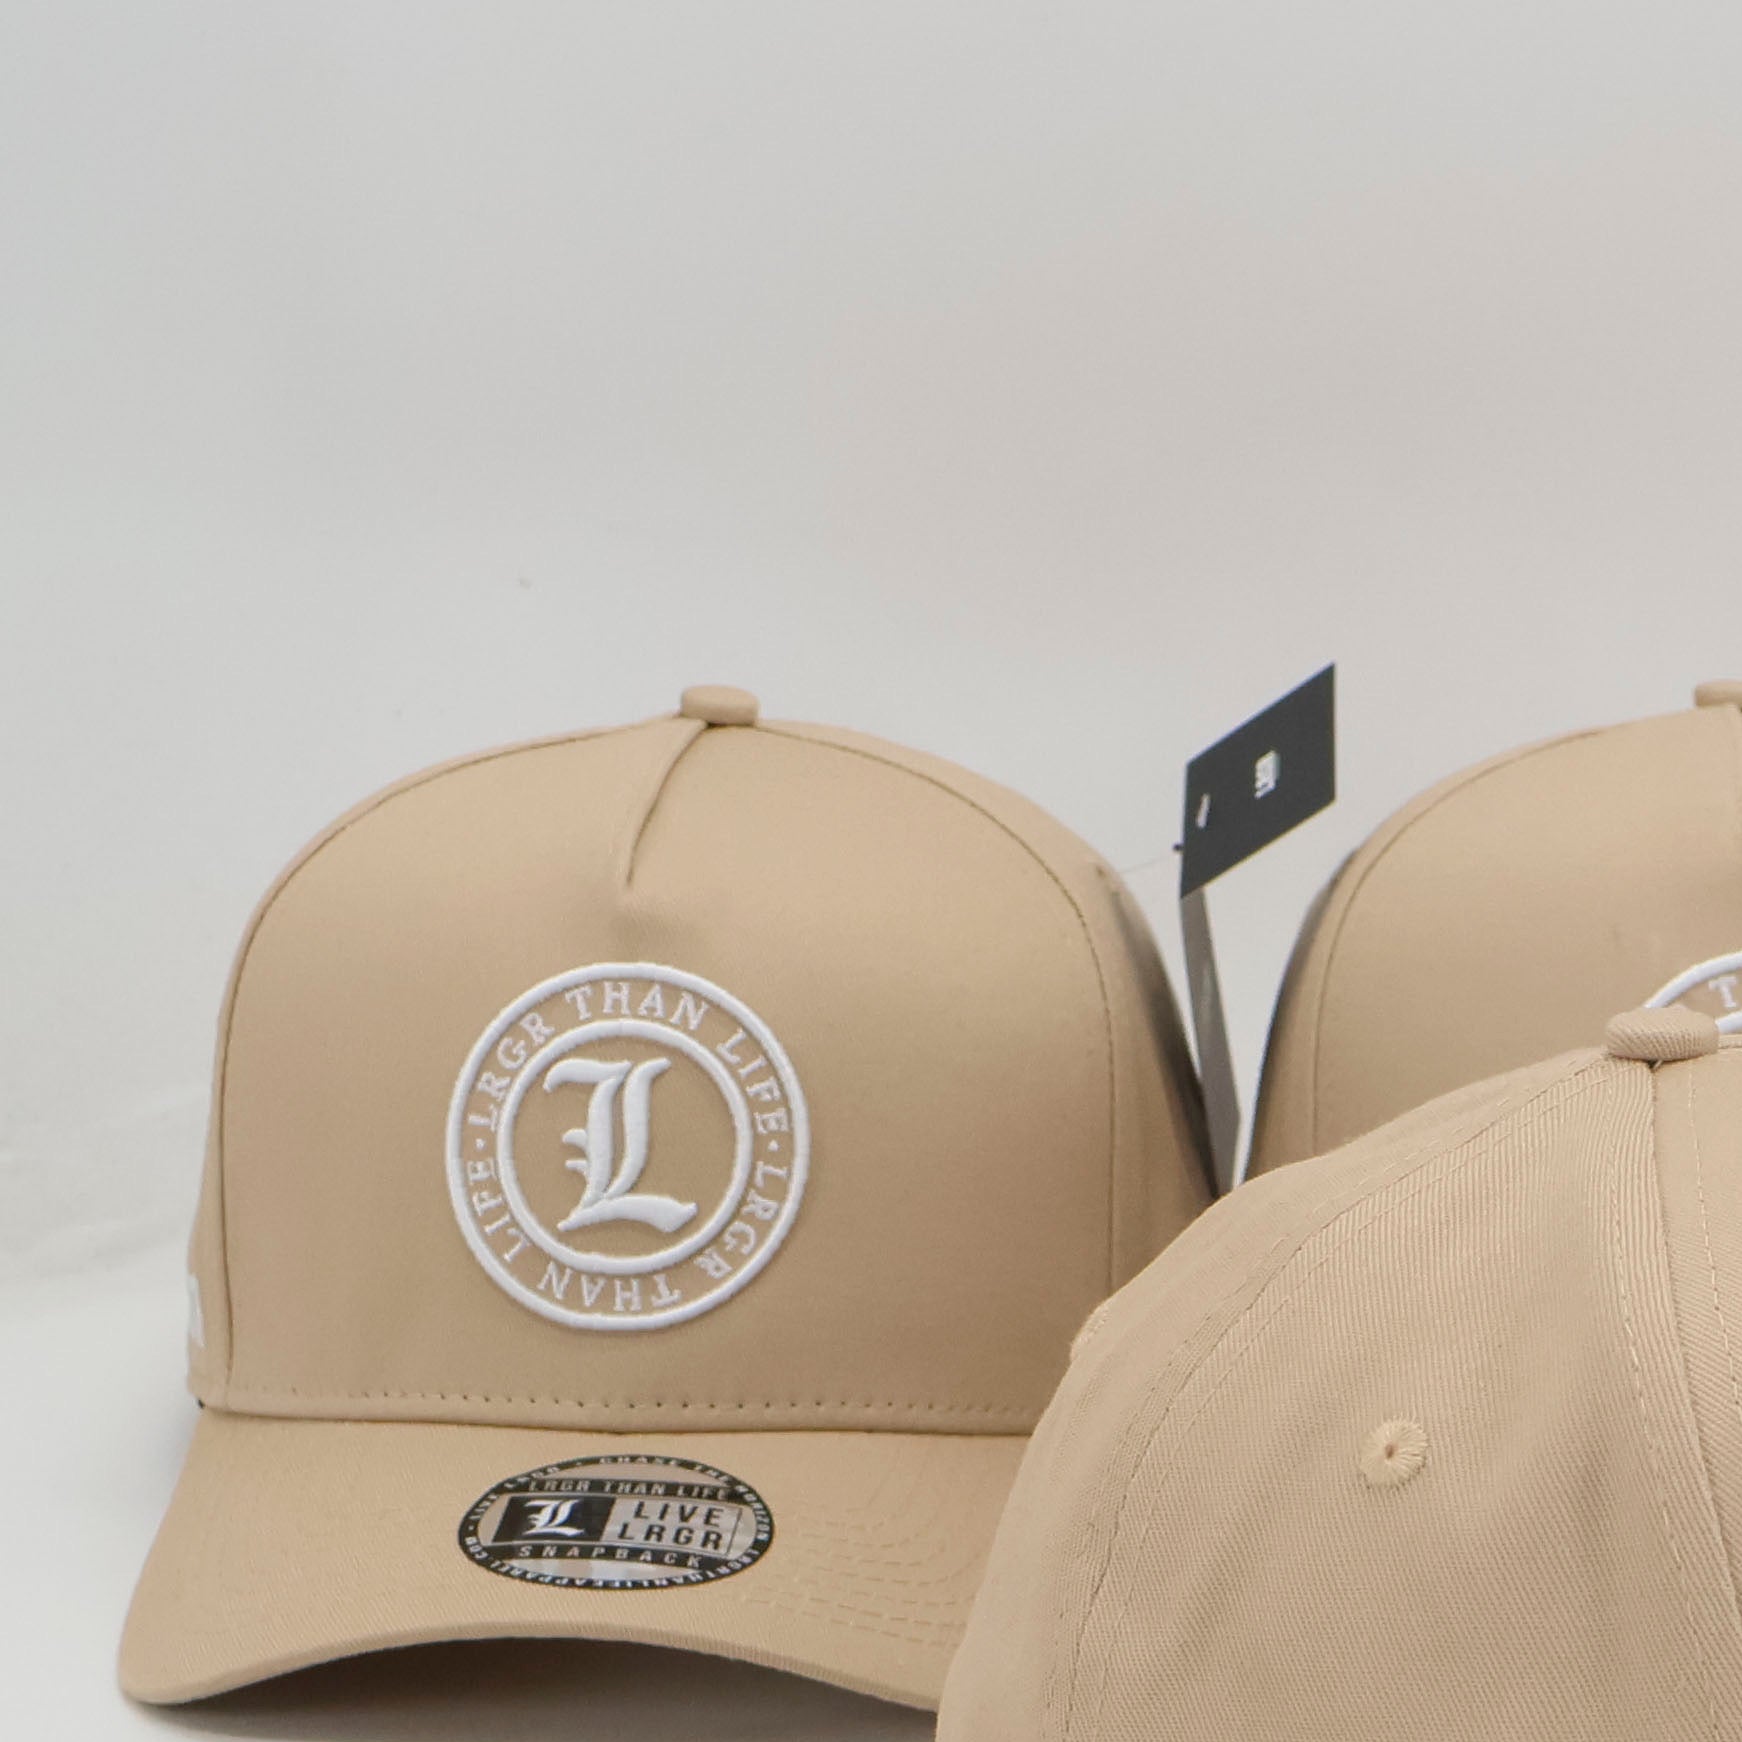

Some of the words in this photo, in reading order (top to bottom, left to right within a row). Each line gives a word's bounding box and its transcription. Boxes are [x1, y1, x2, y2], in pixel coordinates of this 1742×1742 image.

[469, 1012, 555, 1131] LRGR
[565, 981, 709, 1030] THAN
[716, 1027, 789, 1133] LIFE
[697, 1161, 787, 1278] LRGR
[537, 1261, 681, 1312] THAN
[604, 1479, 666, 1496] THAN
[634, 1501, 724, 1528] LIVE
[617, 1522, 723, 1551] LRGR
[519, 1545, 702, 1568] SNAPBACK
